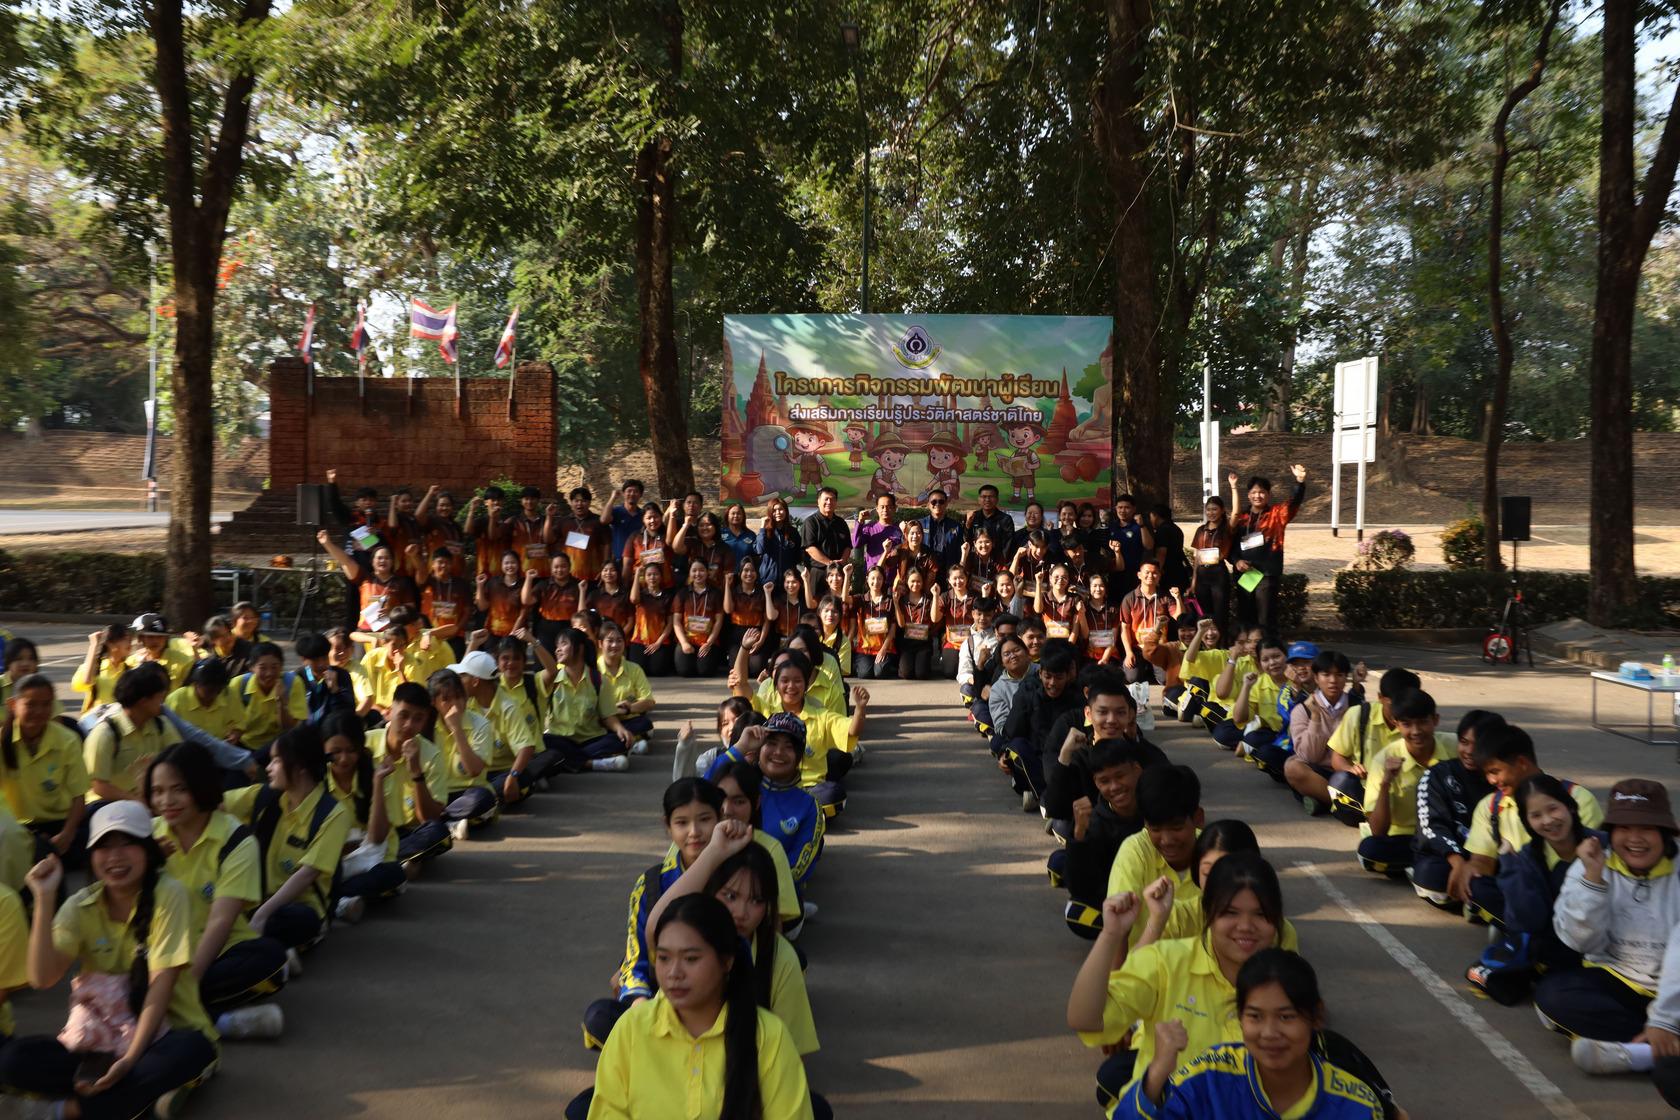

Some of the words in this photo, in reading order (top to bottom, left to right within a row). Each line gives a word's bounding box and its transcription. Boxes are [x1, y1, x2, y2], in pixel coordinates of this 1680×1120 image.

[775, 373, 1059, 403] โครงการกิจกรรมพัฒนาผู้เรียน
[790, 404, 1042, 425] ส่งเสริมการเรียนรู้ประวัติศาสตร์ชาติไทย
